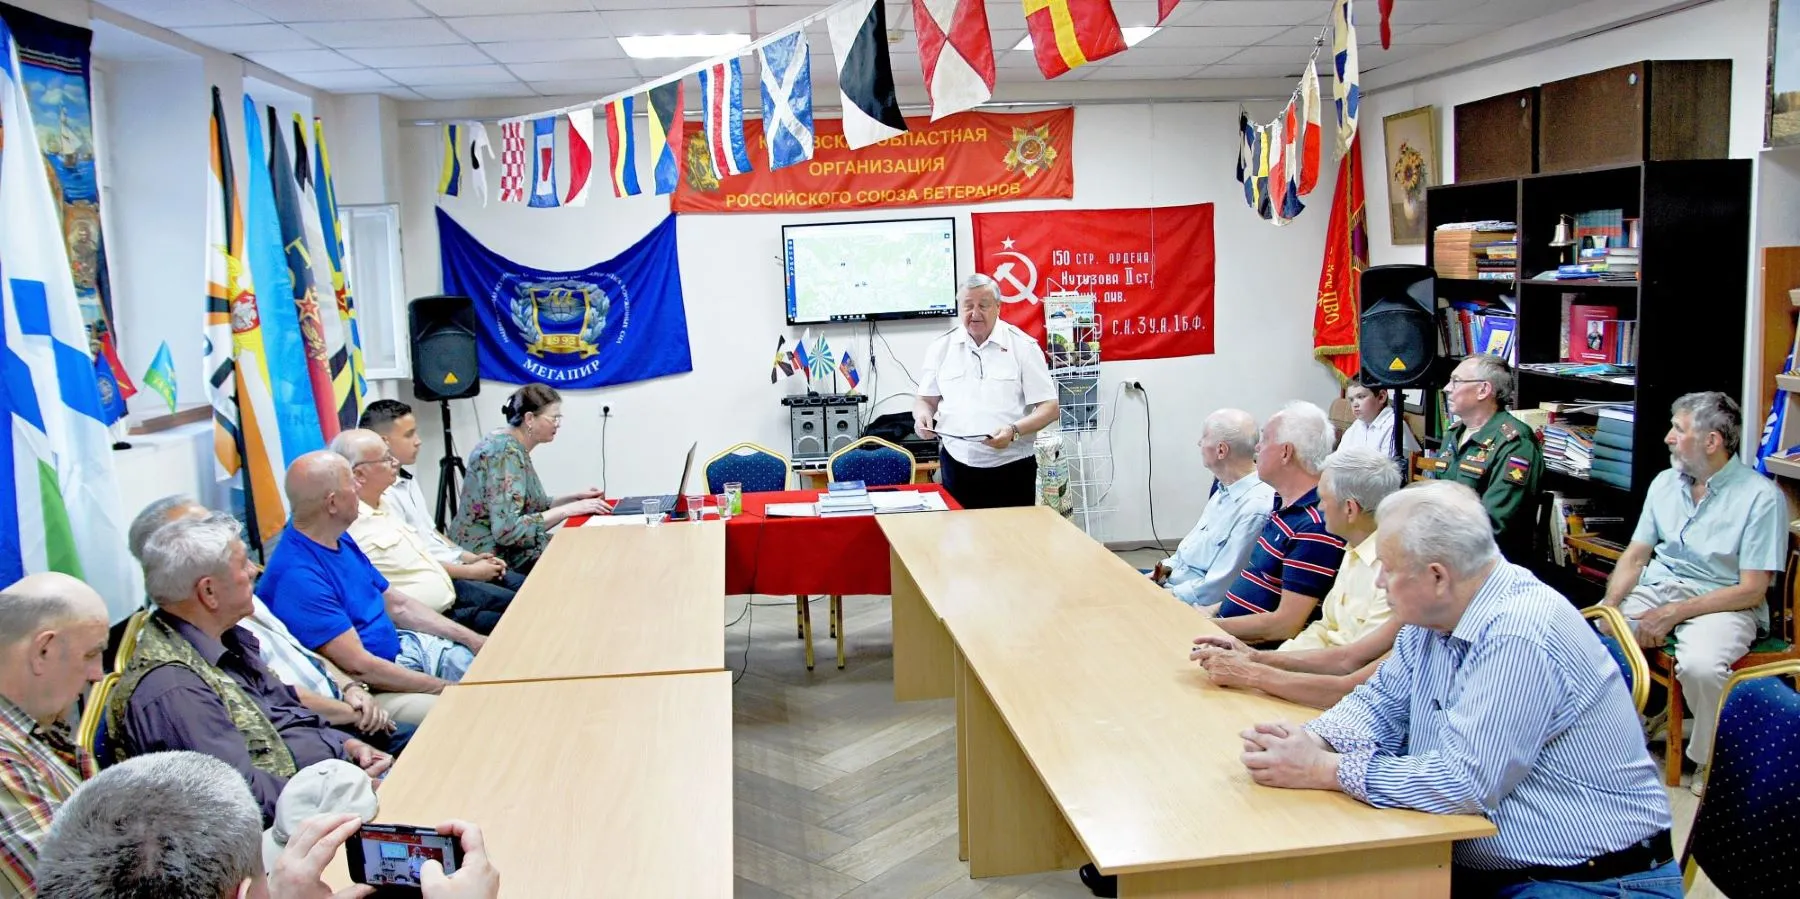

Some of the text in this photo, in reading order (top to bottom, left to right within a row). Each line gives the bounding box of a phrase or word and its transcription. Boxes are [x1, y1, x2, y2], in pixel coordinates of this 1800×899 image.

[809, 157, 944, 176] ОРГАНИЗАЦИЯ
[726, 182, 1021, 208] РОССИЙСКОГО СОЮЗА ВЕТЕРАНОВ
[1052, 250, 1070, 266] 150
[1109, 252, 1149, 264] ОРДЕНА
[1322, 289, 1340, 325] ПВО
[522, 358, 600, 381] МЕГАПИР
